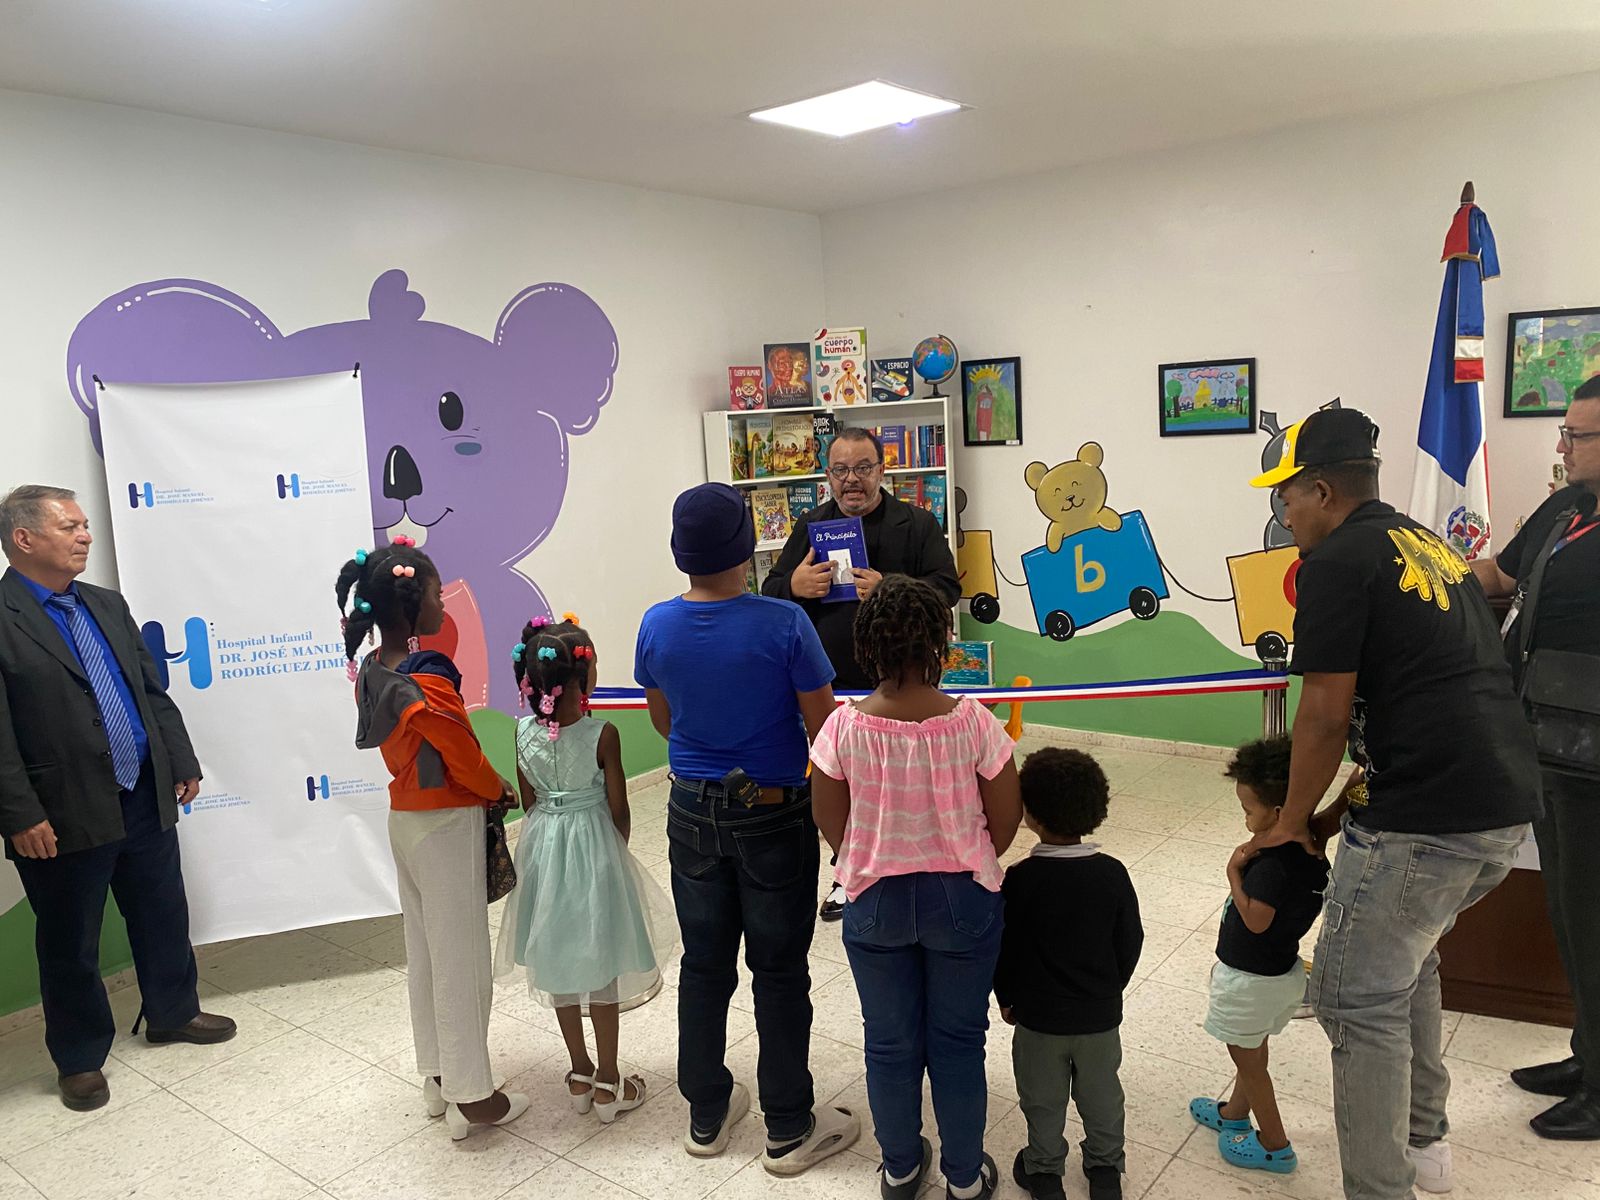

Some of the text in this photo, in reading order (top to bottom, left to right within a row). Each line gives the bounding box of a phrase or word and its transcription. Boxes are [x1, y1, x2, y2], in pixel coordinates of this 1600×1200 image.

[824, 339, 853, 348] cuerpo
[887, 362, 909, 370] ESPACIO
[1074, 543, 1106, 593] b
[217, 631, 313, 650] Hospital Infantil
[220, 642, 346, 665] DR. JOSÉ MANUE
[221, 660, 311, 680] RODRÍGUEZ
